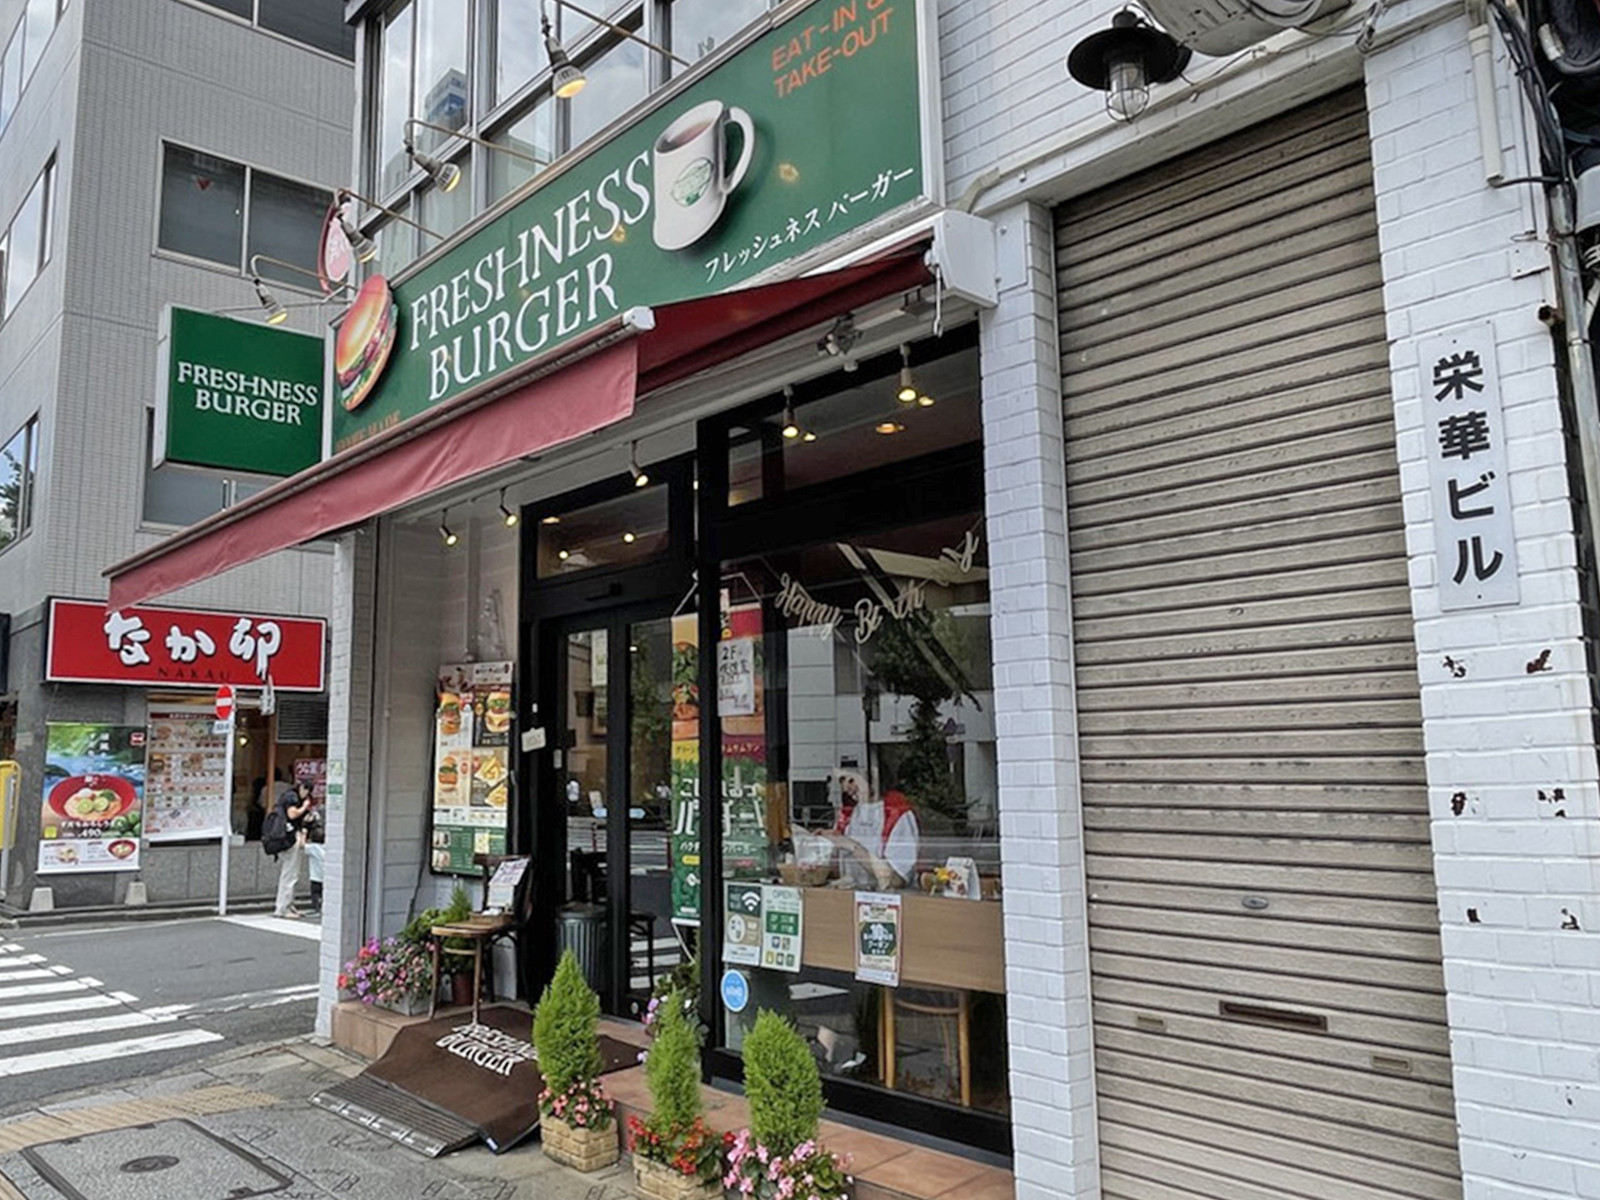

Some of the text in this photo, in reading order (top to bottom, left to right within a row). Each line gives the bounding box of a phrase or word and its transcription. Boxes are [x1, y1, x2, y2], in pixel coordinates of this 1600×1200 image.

[773, 8, 894, 98] TAKE-OUT
[410, 150, 650, 351] FRESHNESS
[428, 253, 619, 401] BURGER
[177, 361, 319, 407] FRESHNESS
[195, 388, 302, 425] BURGER
[1433, 350, 1504, 585] 栄華ビル
[775, 572, 845, 641] Happy
[104, 610, 281, 681] なか卯
[158, 665, 232, 682] NAKAU
